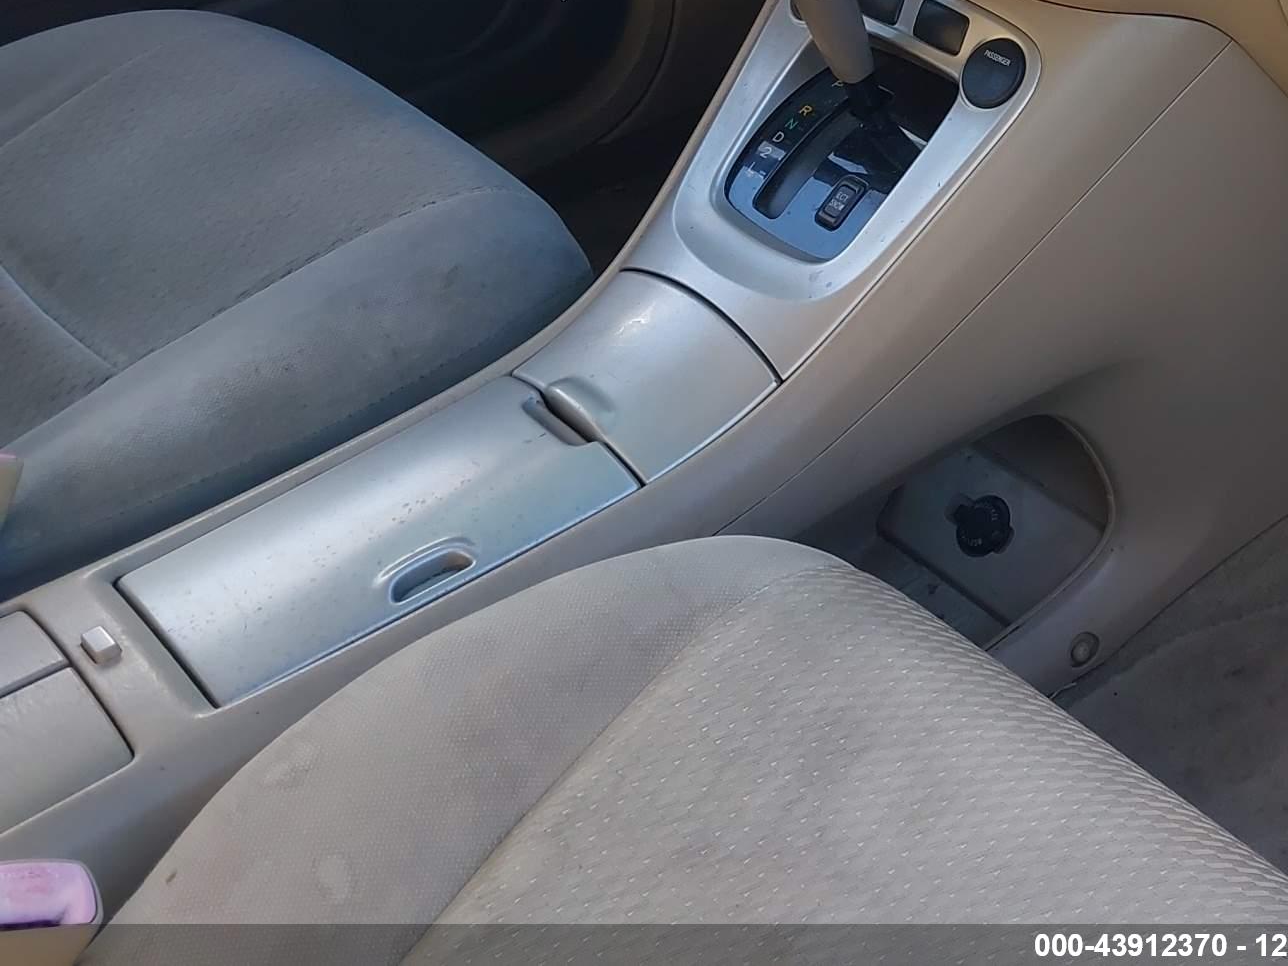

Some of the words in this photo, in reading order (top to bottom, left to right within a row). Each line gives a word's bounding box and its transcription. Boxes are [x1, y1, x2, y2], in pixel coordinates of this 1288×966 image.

[984, 49, 1011, 67] PASSENGER
[799, 105, 813, 116] R
[784, 118, 798, 130] N
[772, 131, 784, 143] D
[760, 146, 772, 158] 2
